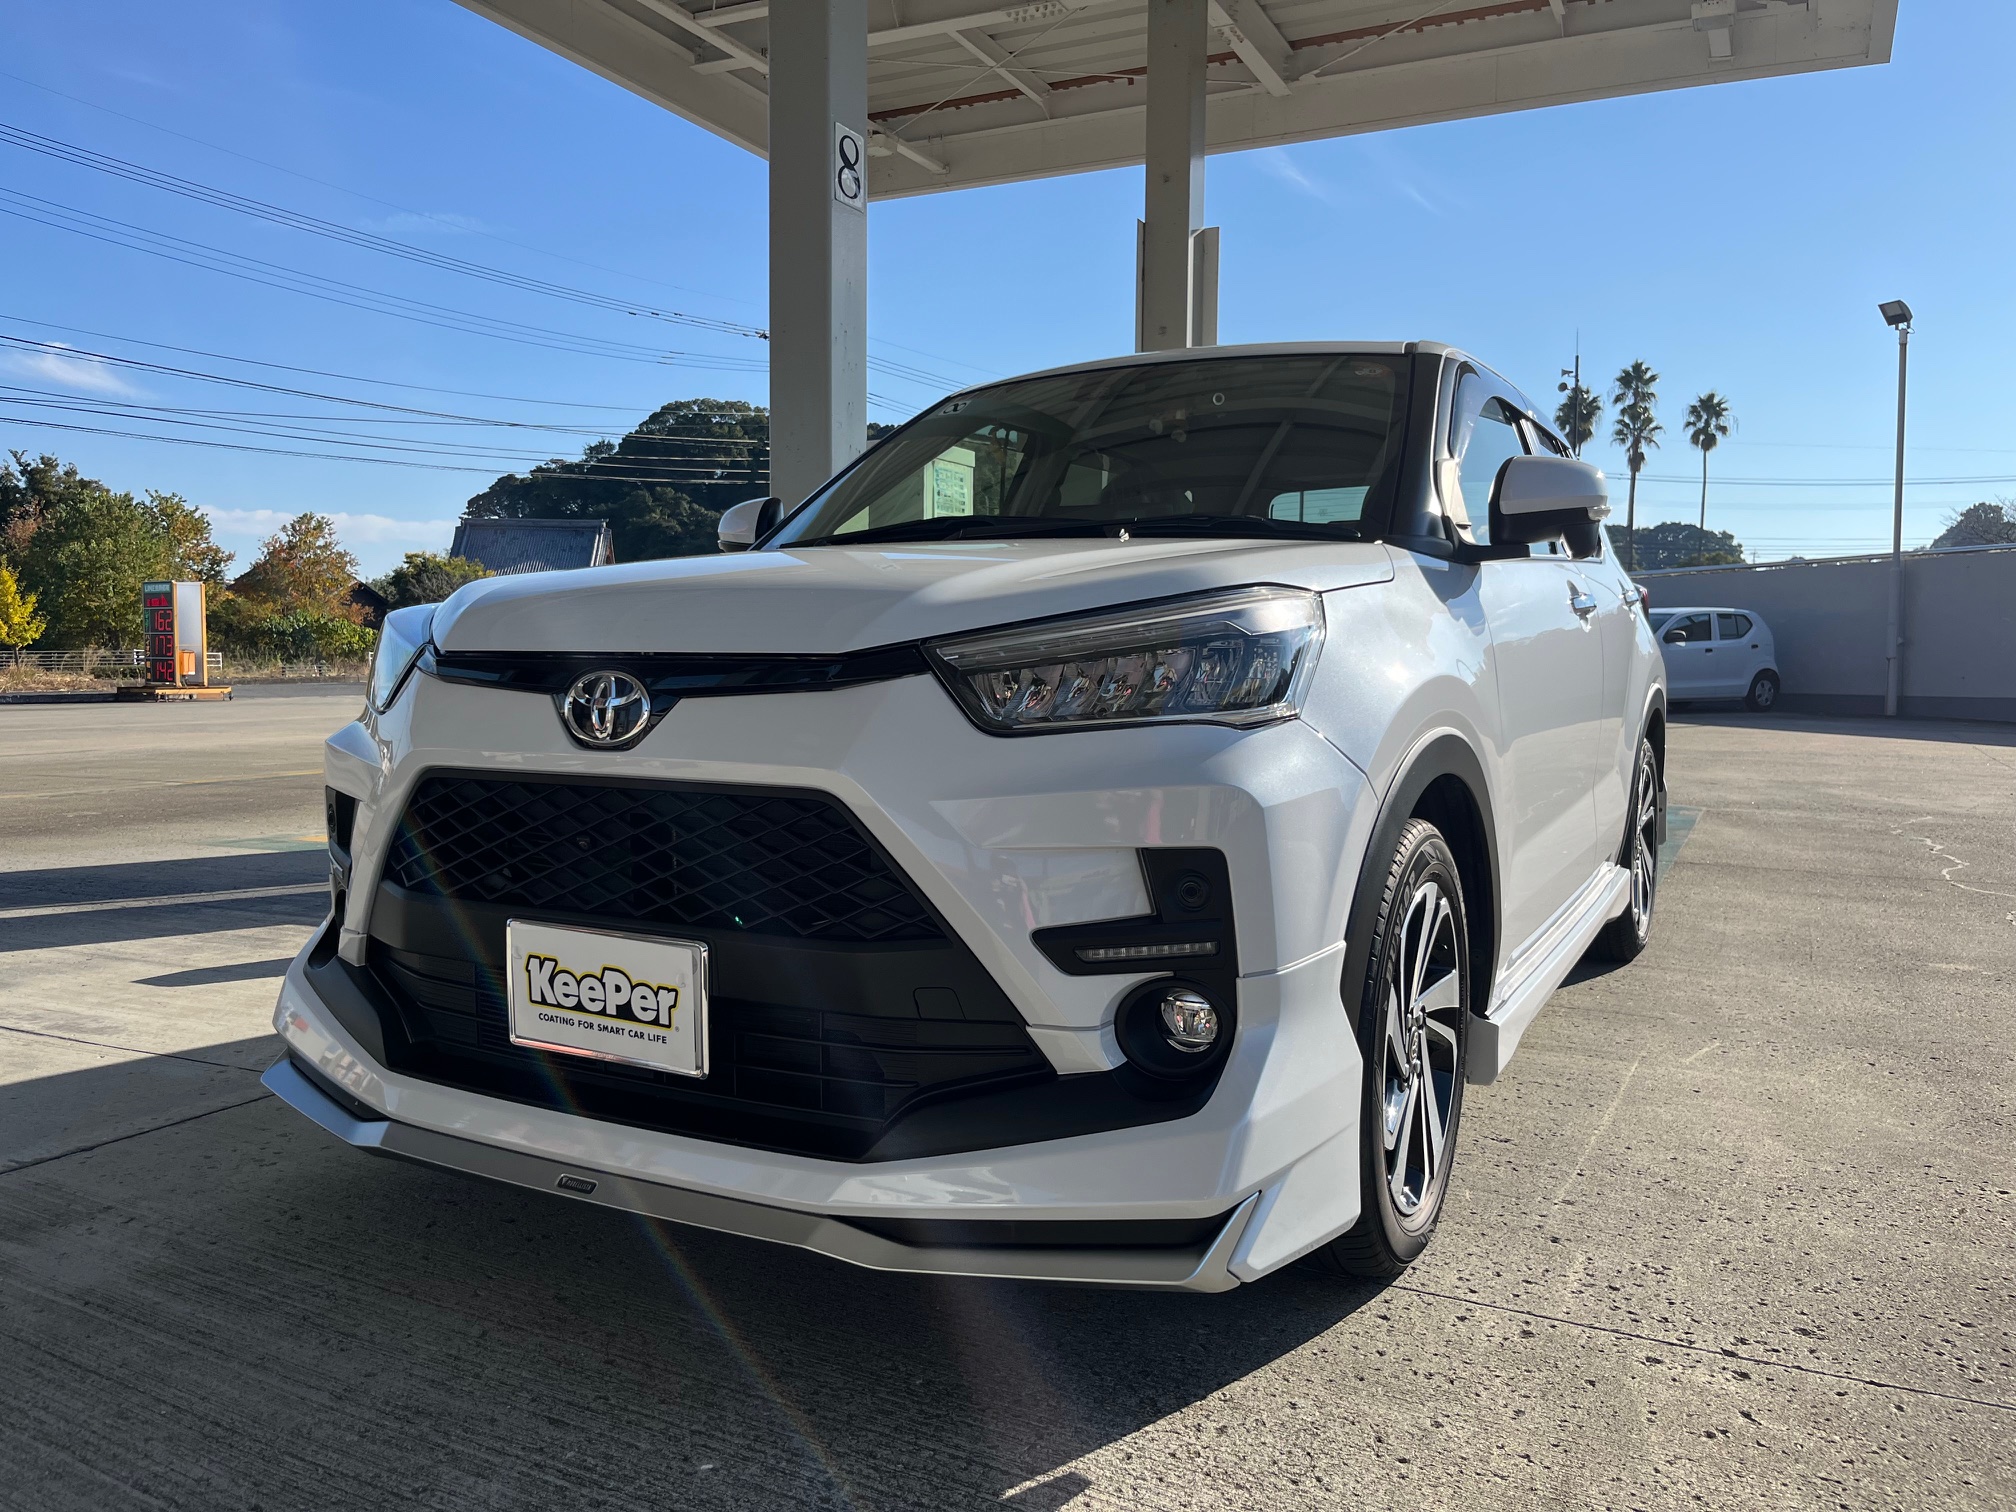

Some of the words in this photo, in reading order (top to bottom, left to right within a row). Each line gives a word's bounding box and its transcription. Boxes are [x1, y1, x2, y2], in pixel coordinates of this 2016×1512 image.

[838, 134, 861, 200] 8
[155, 610, 173, 631] 162
[156, 635, 173, 656] 173
[156, 660, 174, 681] 142
[525, 953, 681, 1030] KeePer
[538, 1012, 575, 1027] COATING
[577, 1020, 595, 1031] FOR
[597, 1023, 626, 1036] SMART
[628, 1029, 645, 1040] CAR
[647, 1032, 668, 1044] LIFE
